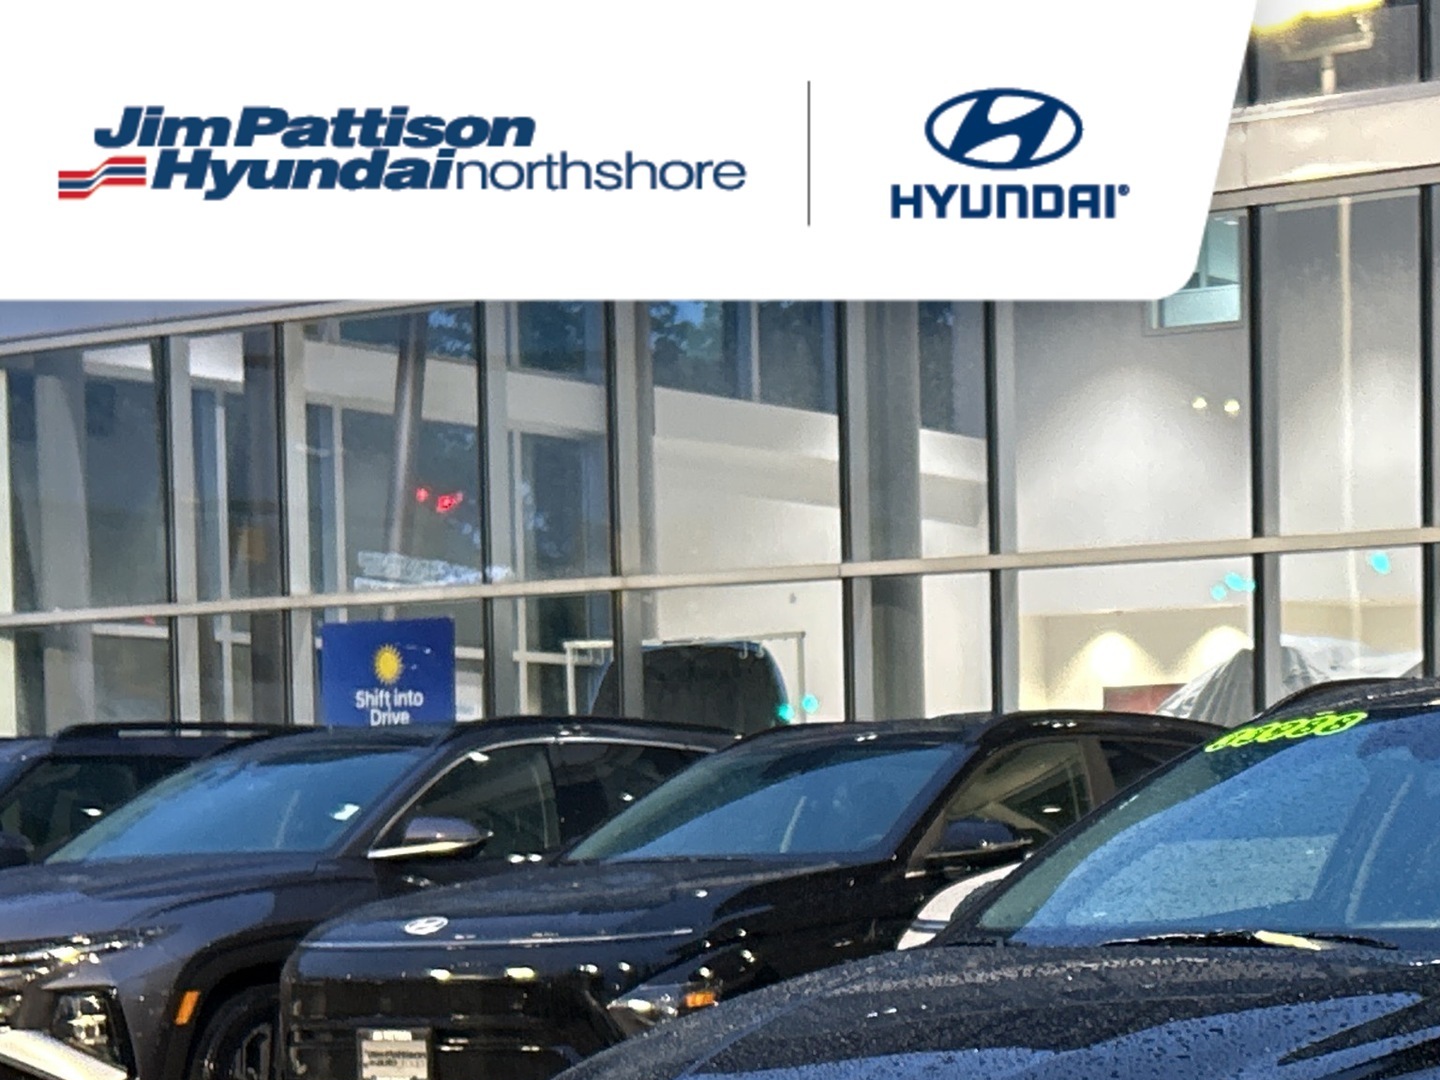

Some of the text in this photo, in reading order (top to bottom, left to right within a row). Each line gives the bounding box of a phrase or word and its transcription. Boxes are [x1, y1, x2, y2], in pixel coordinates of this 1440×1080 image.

[355, 688, 424, 709] Shift into
[370, 708, 410, 727] Drive
